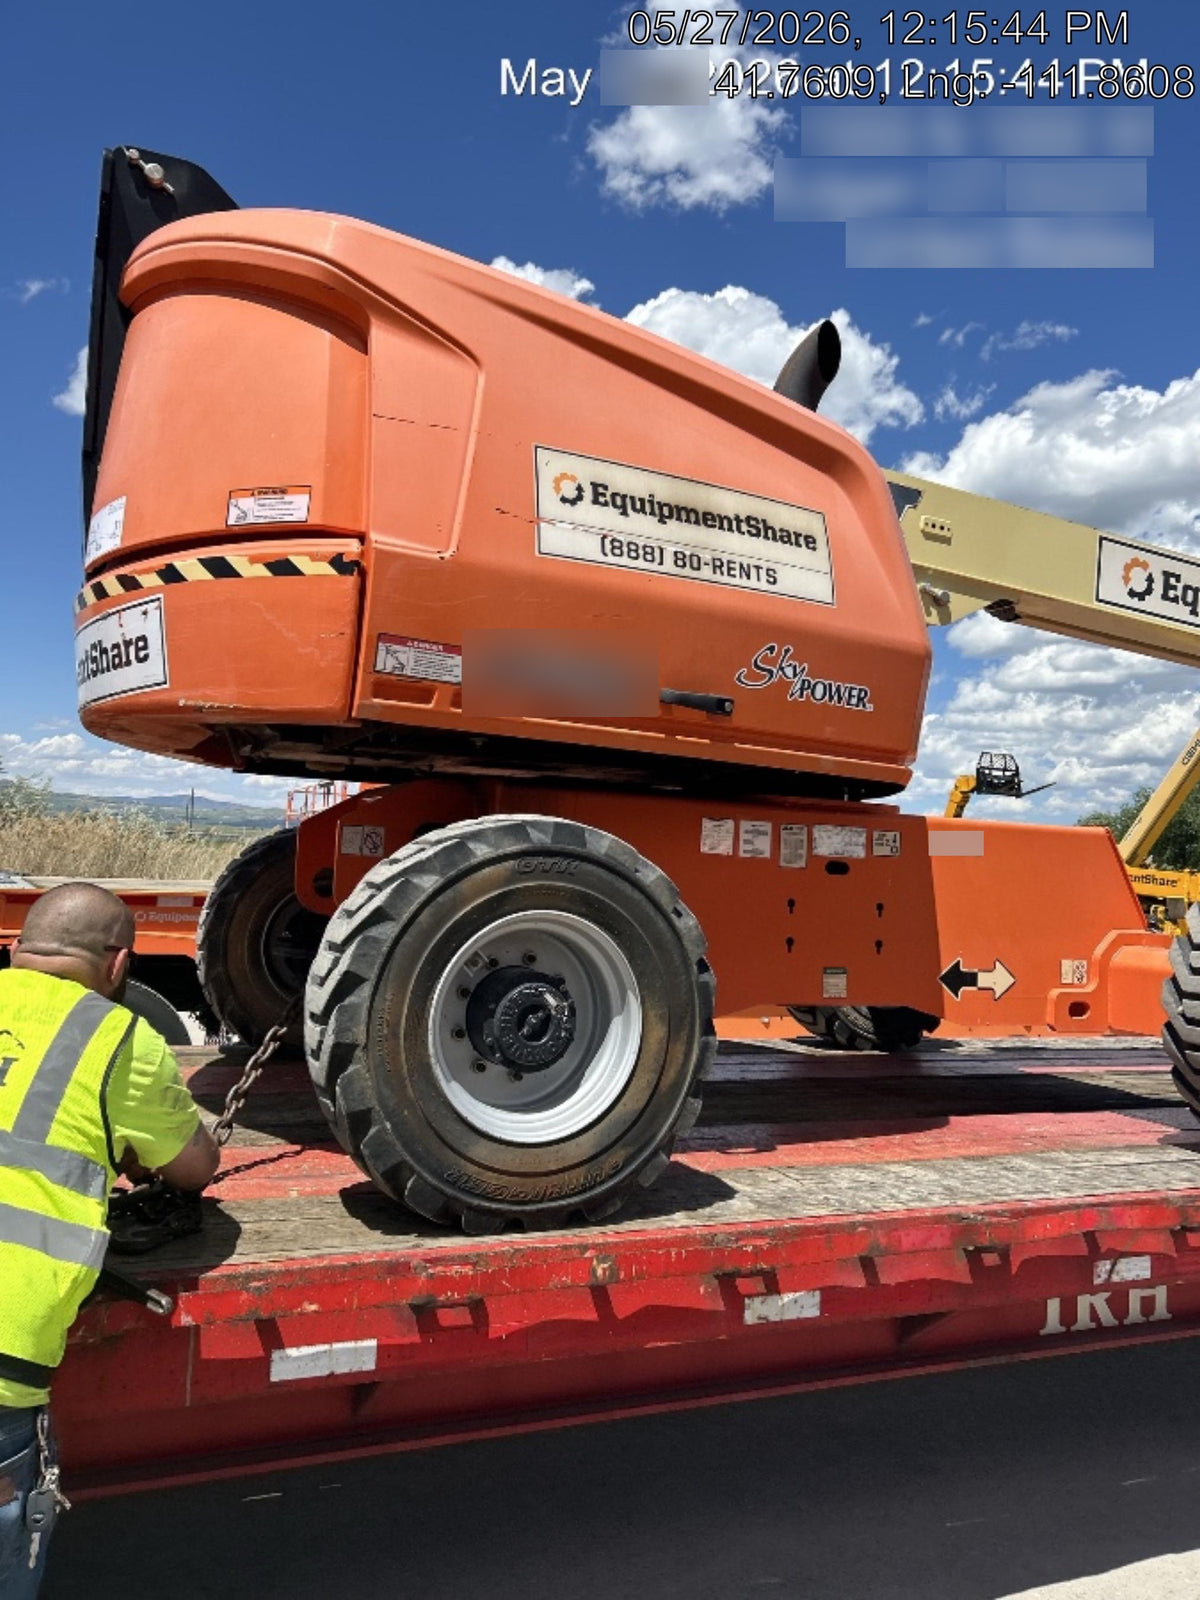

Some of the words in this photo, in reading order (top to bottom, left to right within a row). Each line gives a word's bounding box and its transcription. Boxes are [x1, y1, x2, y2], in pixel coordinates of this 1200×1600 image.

[590, 480, 817, 552] EquipmentShare
[600, 533, 665, 565] (888)
[673, 550, 779, 586] 80-RENTS
[735, 643, 808, 701] Sky
[798, 678, 869, 711] POWER
